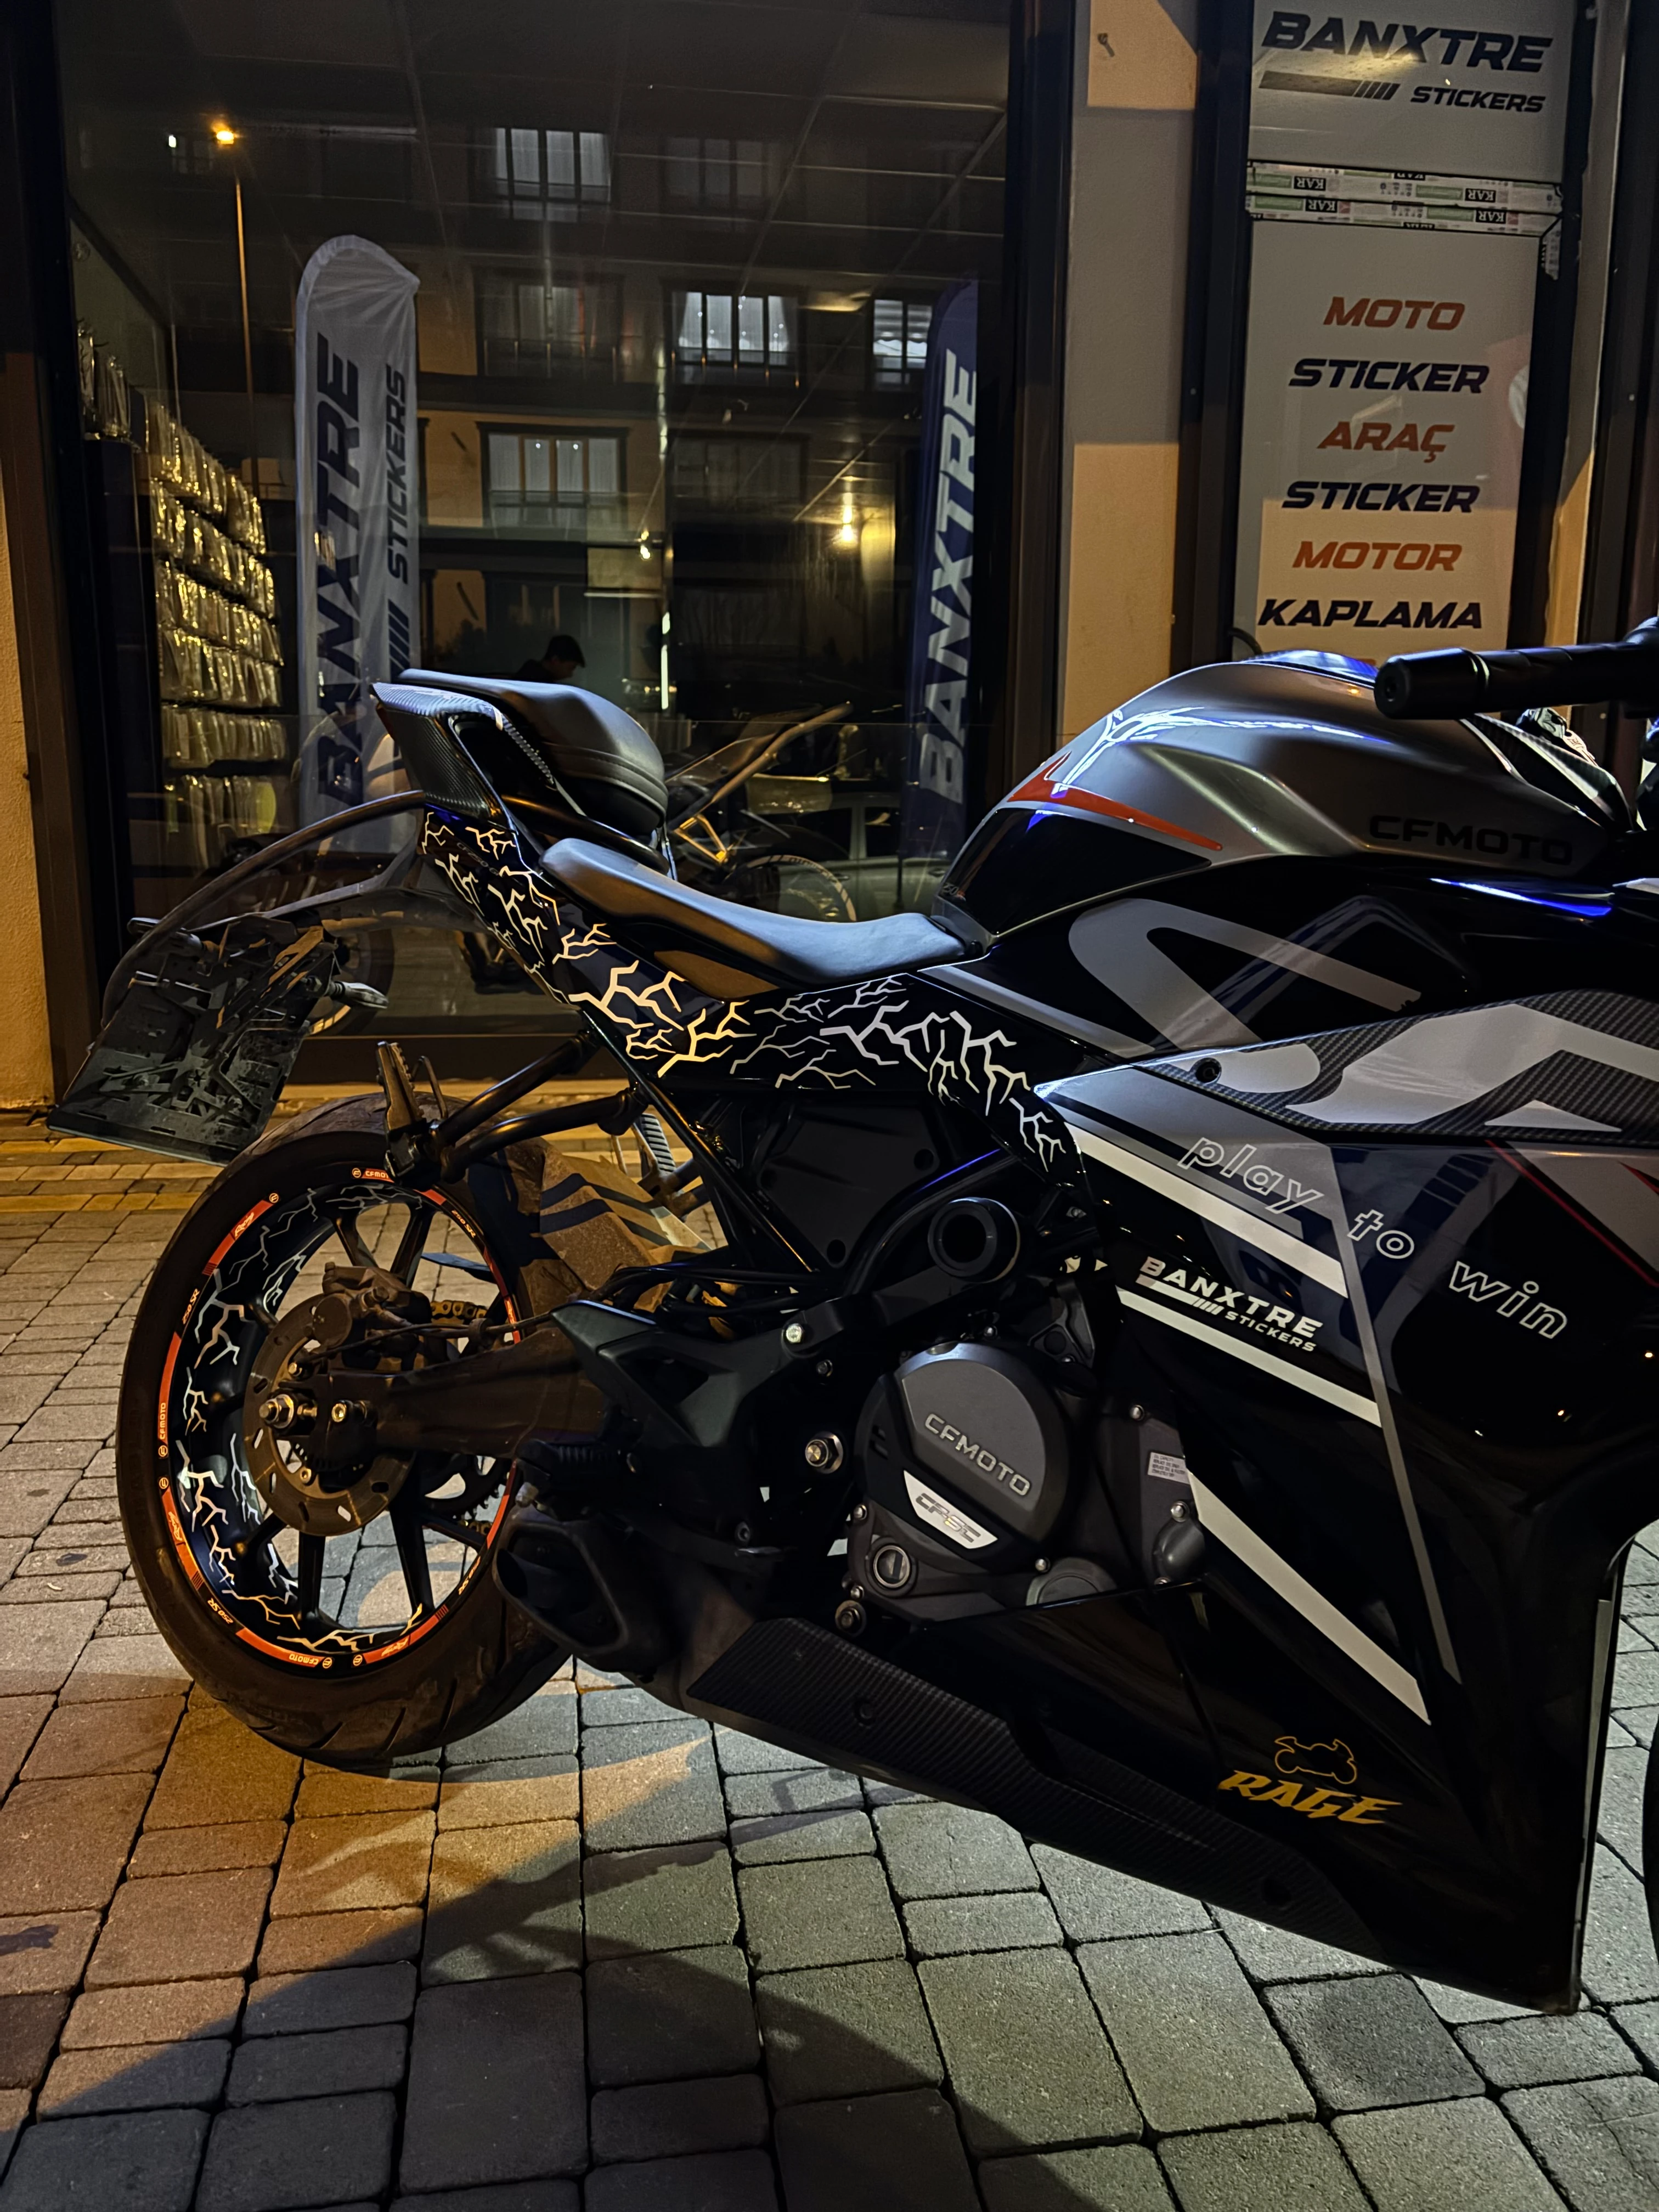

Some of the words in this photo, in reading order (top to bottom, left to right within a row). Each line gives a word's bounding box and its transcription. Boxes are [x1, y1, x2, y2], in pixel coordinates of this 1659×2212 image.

[1261, 10, 1553, 73] BANXTRE
[1410, 86, 1546, 113] STICKERS
[1296, 177, 1324, 190] KAR
[1468, 189, 1494, 202] KAR
[1308, 200, 1336, 212] KAR
[1479, 211, 1505, 223] KAR
[1323, 297, 1465, 331] MOTO
[1289, 358, 1490, 393] STICKER
[1317, 421, 1455, 463] ARAÇ
[386, 362, 408, 584] STICKERS
[1282, 481, 1481, 513] STICKER
[317, 332, 363, 807] BANXTRE
[1292, 541, 1463, 571] MOTOR
[919, 348, 976, 805] BANXTRE
[1257, 599, 1482, 629] KAPLAMA
[1369, 815, 1572, 865] CFMOTO
[1178, 1138, 1324, 1214] play
[1347, 1210, 1415, 1259] to
[1448, 1260, 1567, 1339] win
[182, 1304, 192, 1324] 250
[190, 1288, 200, 1304] SR
[1139, 1256, 1323, 1339] BANXTRE
[1225, 1311, 1317, 1352] STICKERS
[924, 1413, 1031, 1496] CFMOTO
[207, 1597, 223, 1612] SR
[218, 1610, 233, 1624] 250
[289, 1652, 319, 1666] CFMOTO
[1217, 1770, 1403, 1824] RAGE
